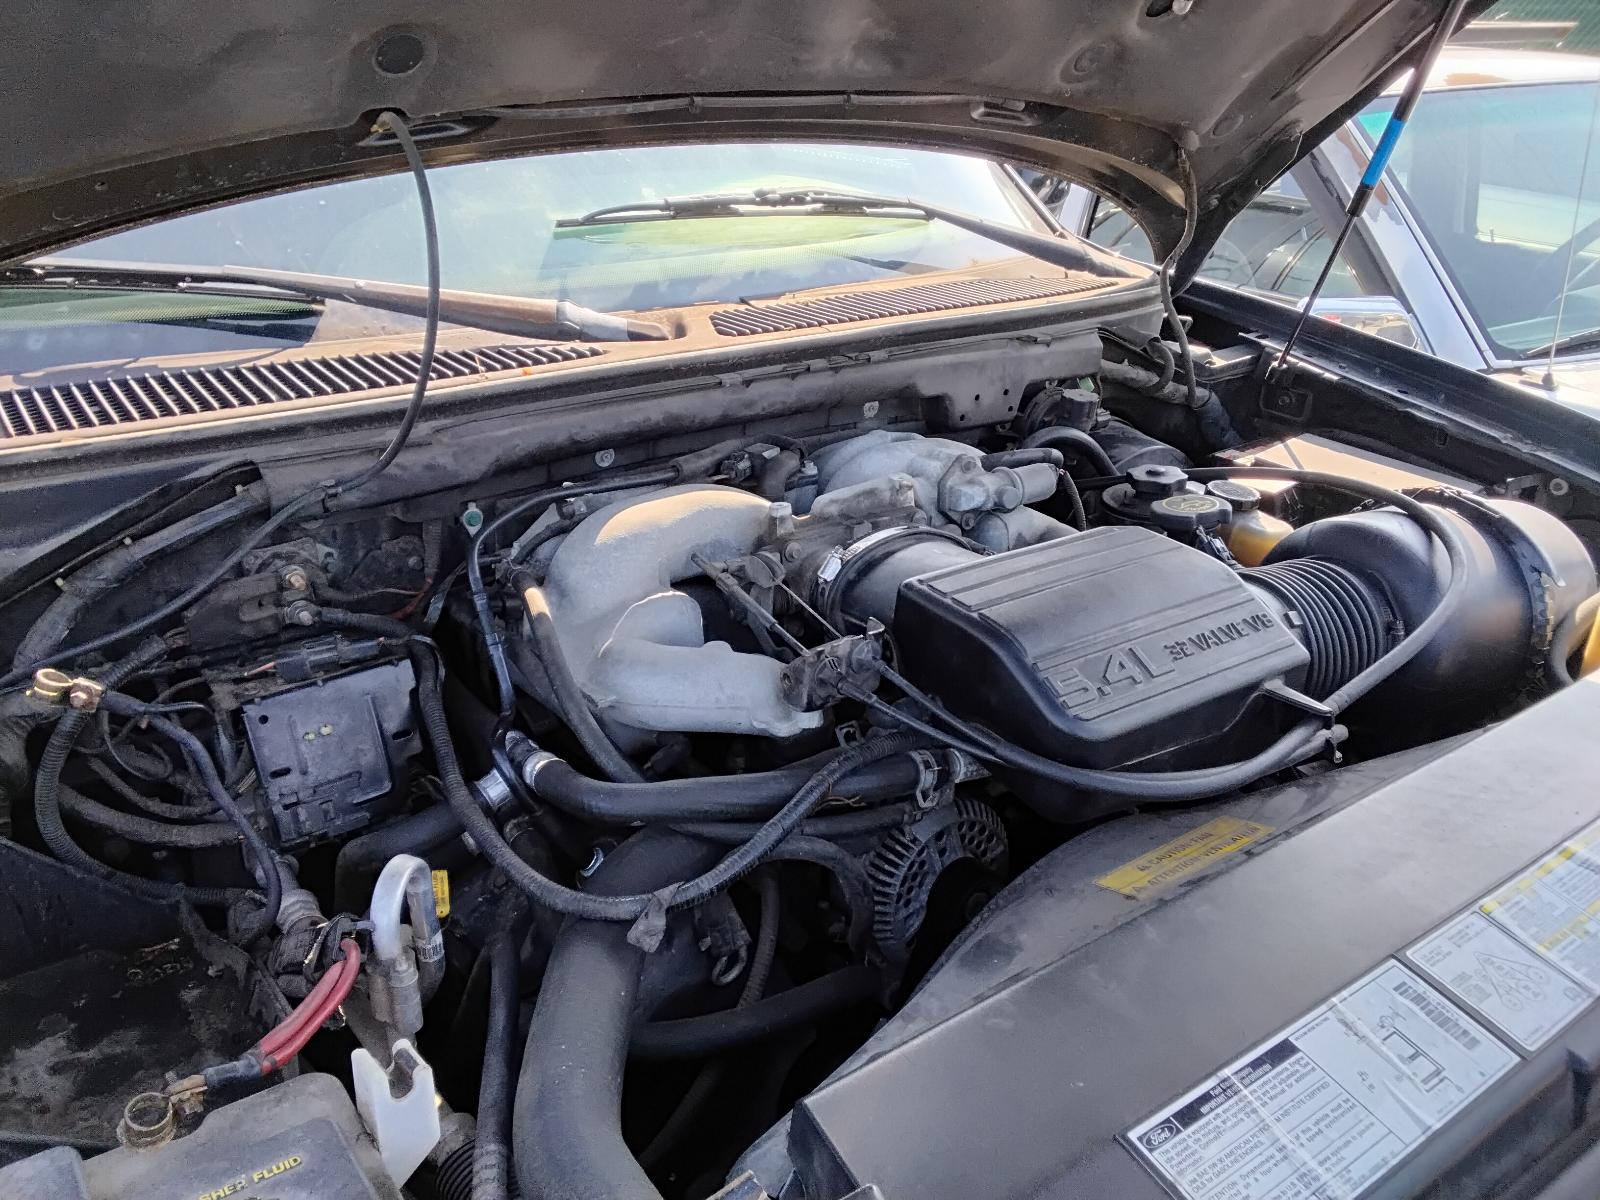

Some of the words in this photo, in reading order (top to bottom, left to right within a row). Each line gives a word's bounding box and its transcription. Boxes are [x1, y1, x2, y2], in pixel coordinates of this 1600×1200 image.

[1043, 645, 1176, 709] 5.4L
[1187, 621, 1250, 652] VALVE
[1241, 613, 1274, 633] V8
[1200, 1094, 1226, 1114] IMPORTANT
[1242, 1065, 1270, 1085] INFORMATION
[1149, 1127, 1169, 1146] Ford
[1159, 1148, 1169, 1158] This
[1169, 1136, 1185, 1150] vehicle
[1191, 1120, 1212, 1137] equipped
[1223, 1138, 1251, 1159] AMERICAN
[199, 1175, 248, 1200] SHER
[253, 1156, 301, 1183] FLUID
